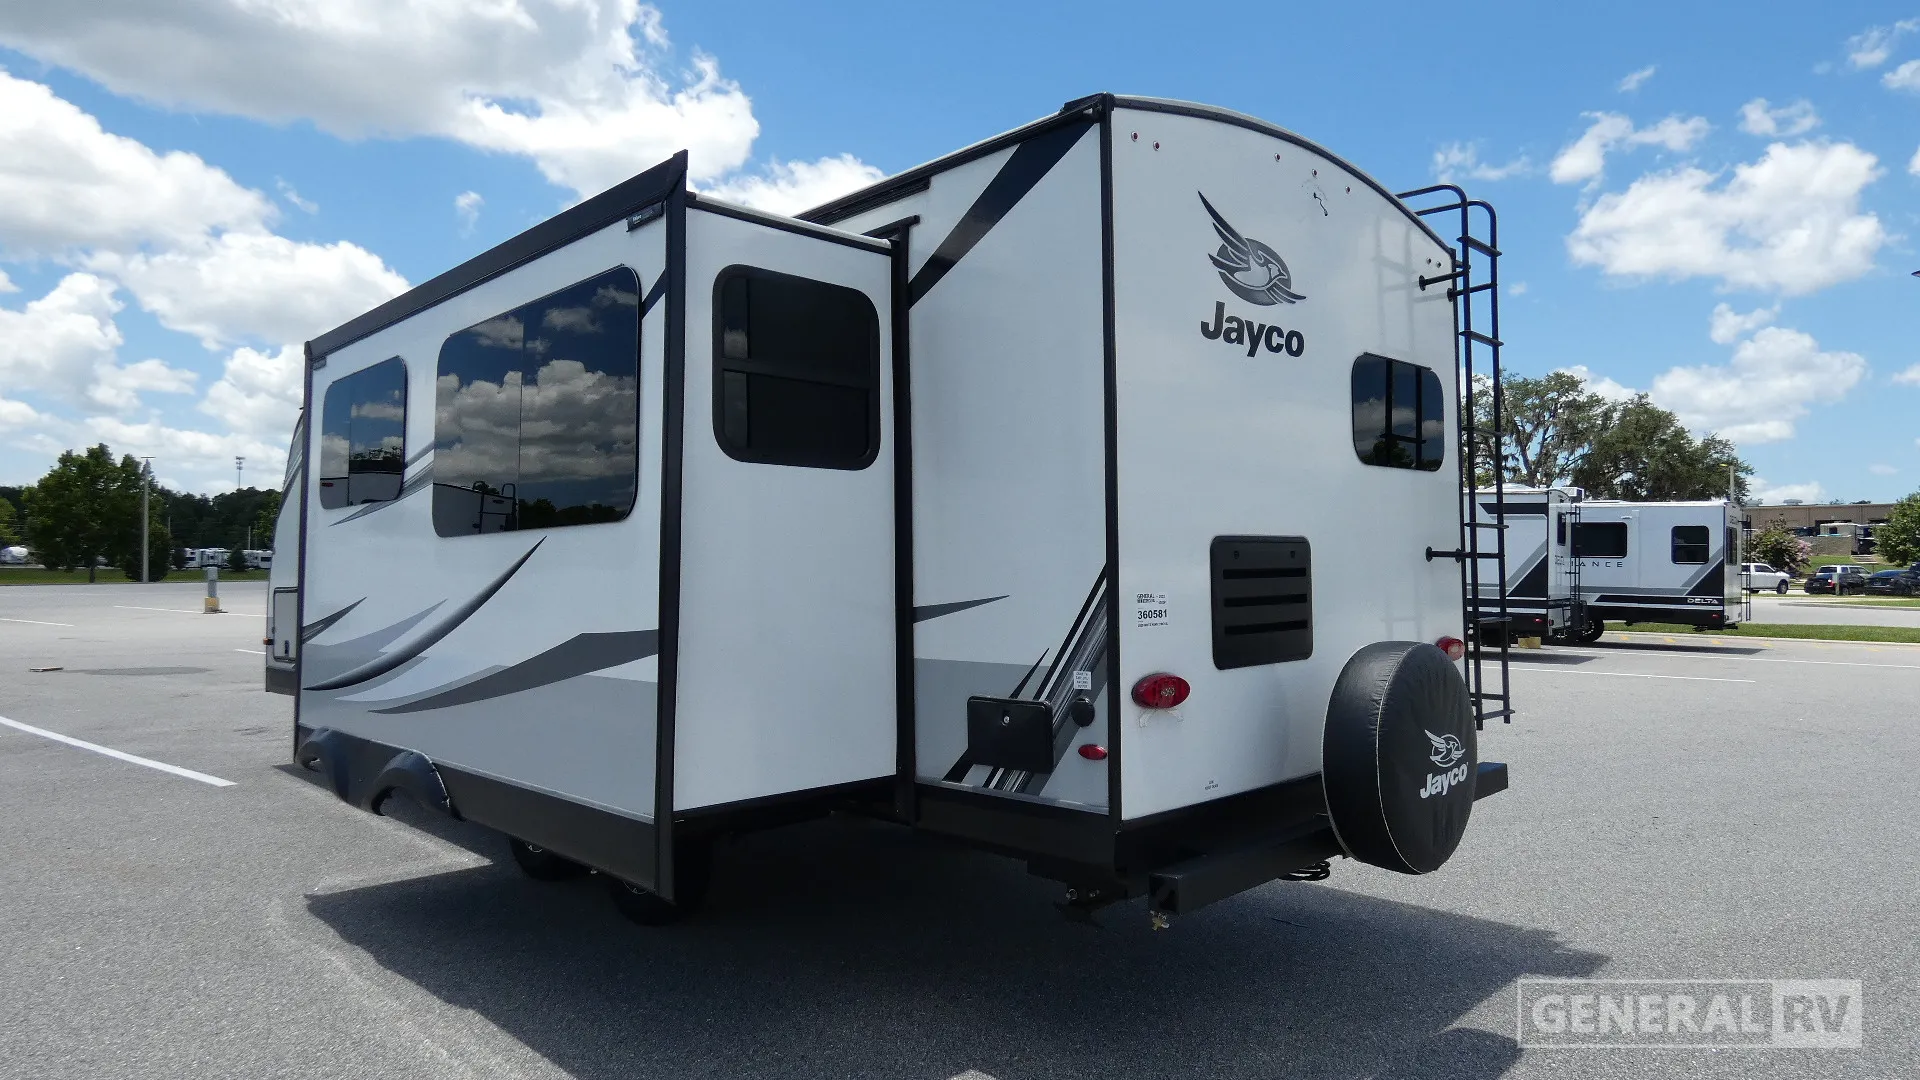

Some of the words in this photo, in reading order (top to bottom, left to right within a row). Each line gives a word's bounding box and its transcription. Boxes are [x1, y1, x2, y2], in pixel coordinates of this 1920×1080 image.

[1200, 300, 1305, 358] Jayco
[1687, 597, 1719, 605] DELTA
[1137, 609, 1168, 620] 360581
[1420, 763, 1468, 799] Jayco
